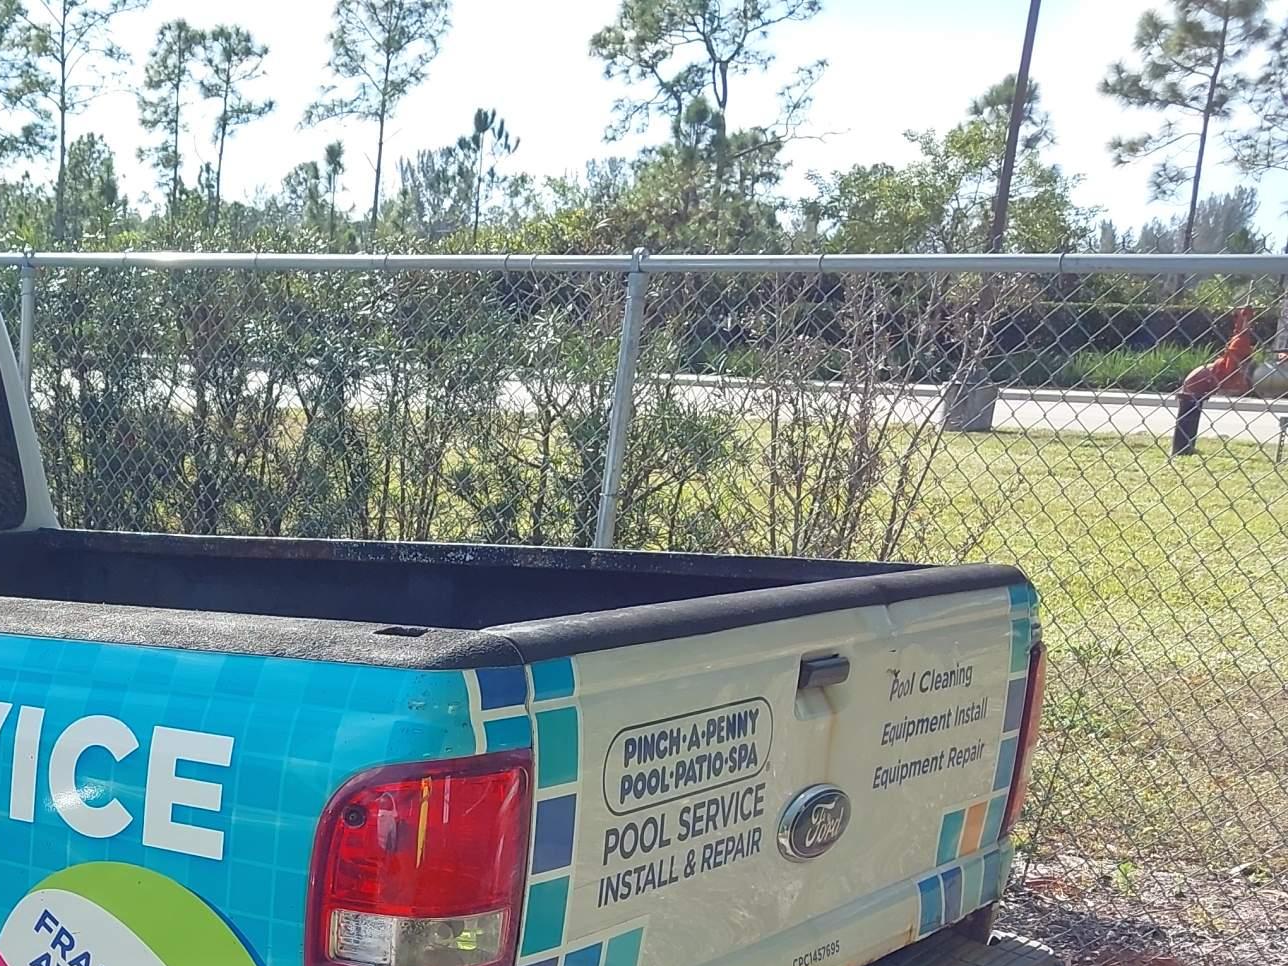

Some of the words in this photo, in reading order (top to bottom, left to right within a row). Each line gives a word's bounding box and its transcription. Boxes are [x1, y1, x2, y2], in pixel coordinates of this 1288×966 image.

[889, 672, 916, 701] Pool
[919, 662, 973, 693] Cleaning
[881, 708, 952, 746] Equipment
[954, 697, 988, 727] Install
[872, 750, 945, 789] Equipment
[947, 739, 985, 768] Repair
[603, 813, 671, 866] POOL
[677, 782, 766, 842] SERVICE
[805, 798, 844, 847] Ford
[598, 855, 679, 908] INSTALL
[683, 848, 696, 879] &
[700, 826, 762, 873] REPAIR
